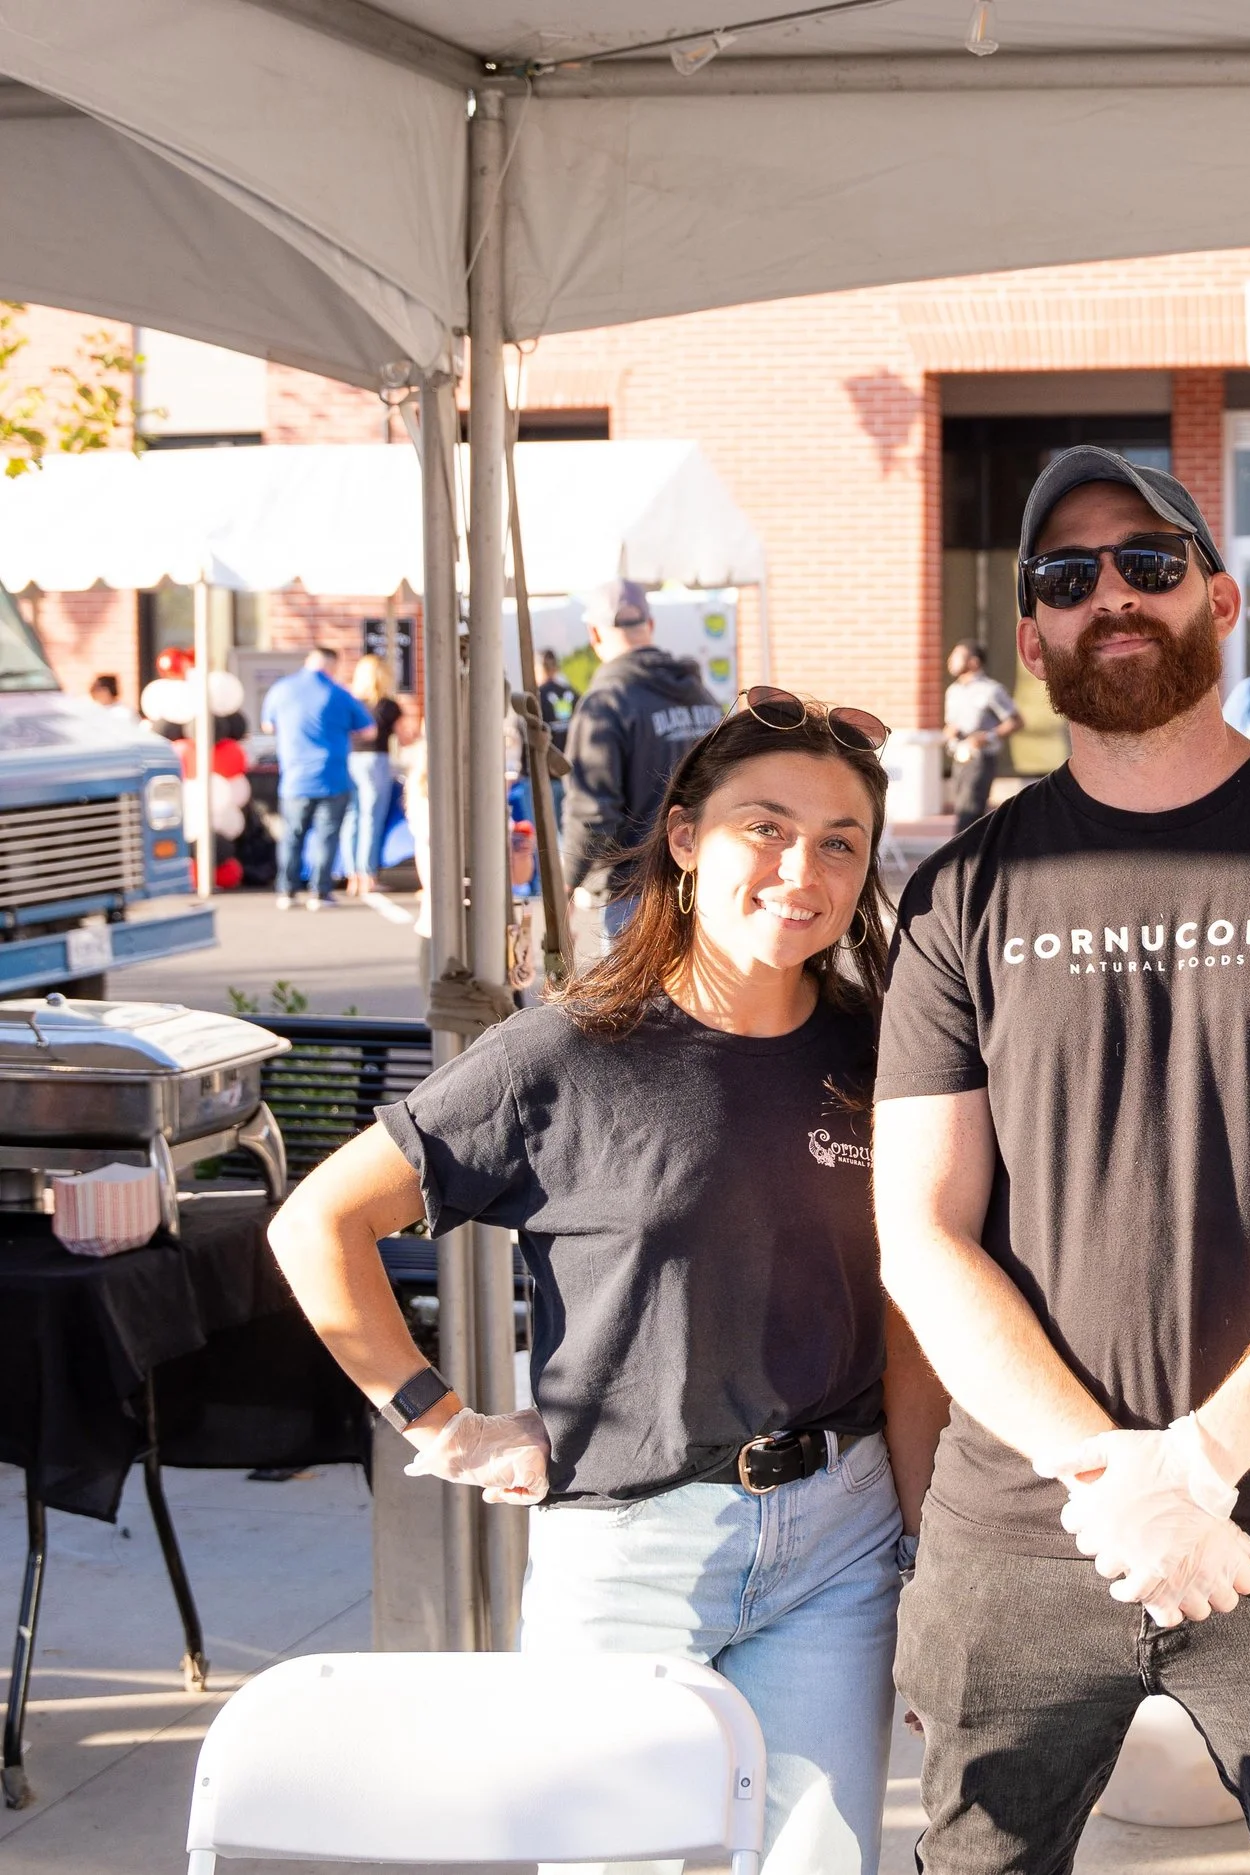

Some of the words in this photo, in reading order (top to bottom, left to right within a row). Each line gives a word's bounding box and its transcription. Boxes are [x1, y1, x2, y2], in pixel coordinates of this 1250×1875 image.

[1069, 961, 1166, 975] NATURAL
[1178, 954, 1245, 971] FOODS
[838, 1157, 866, 1168] NATURAL
